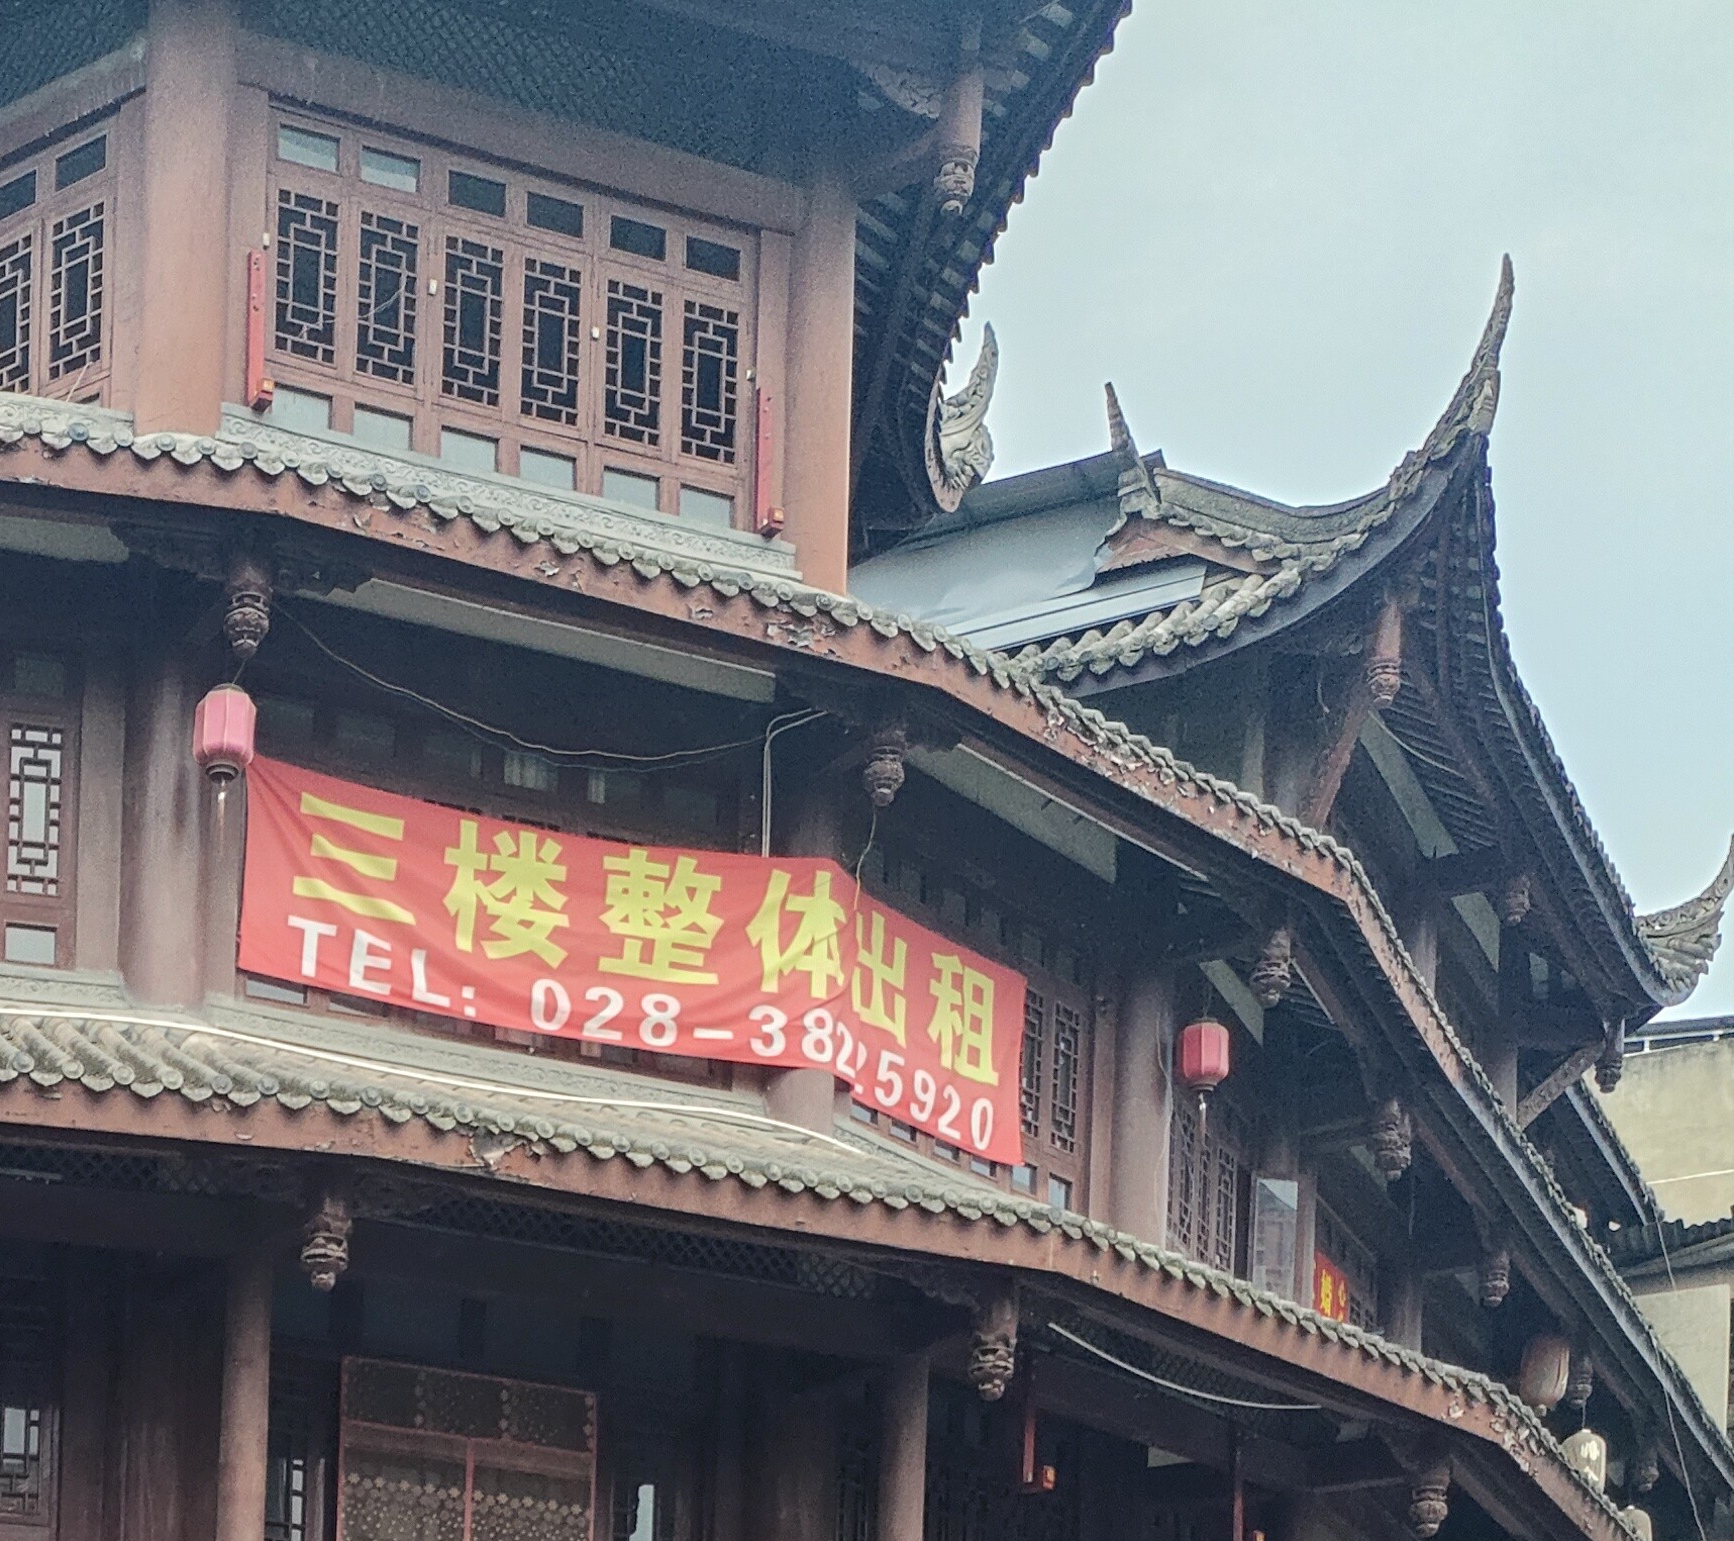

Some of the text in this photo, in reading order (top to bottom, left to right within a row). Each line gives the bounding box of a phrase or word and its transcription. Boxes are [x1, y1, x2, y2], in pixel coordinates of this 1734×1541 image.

[292, 790, 999, 1088] 三楼整体出租
